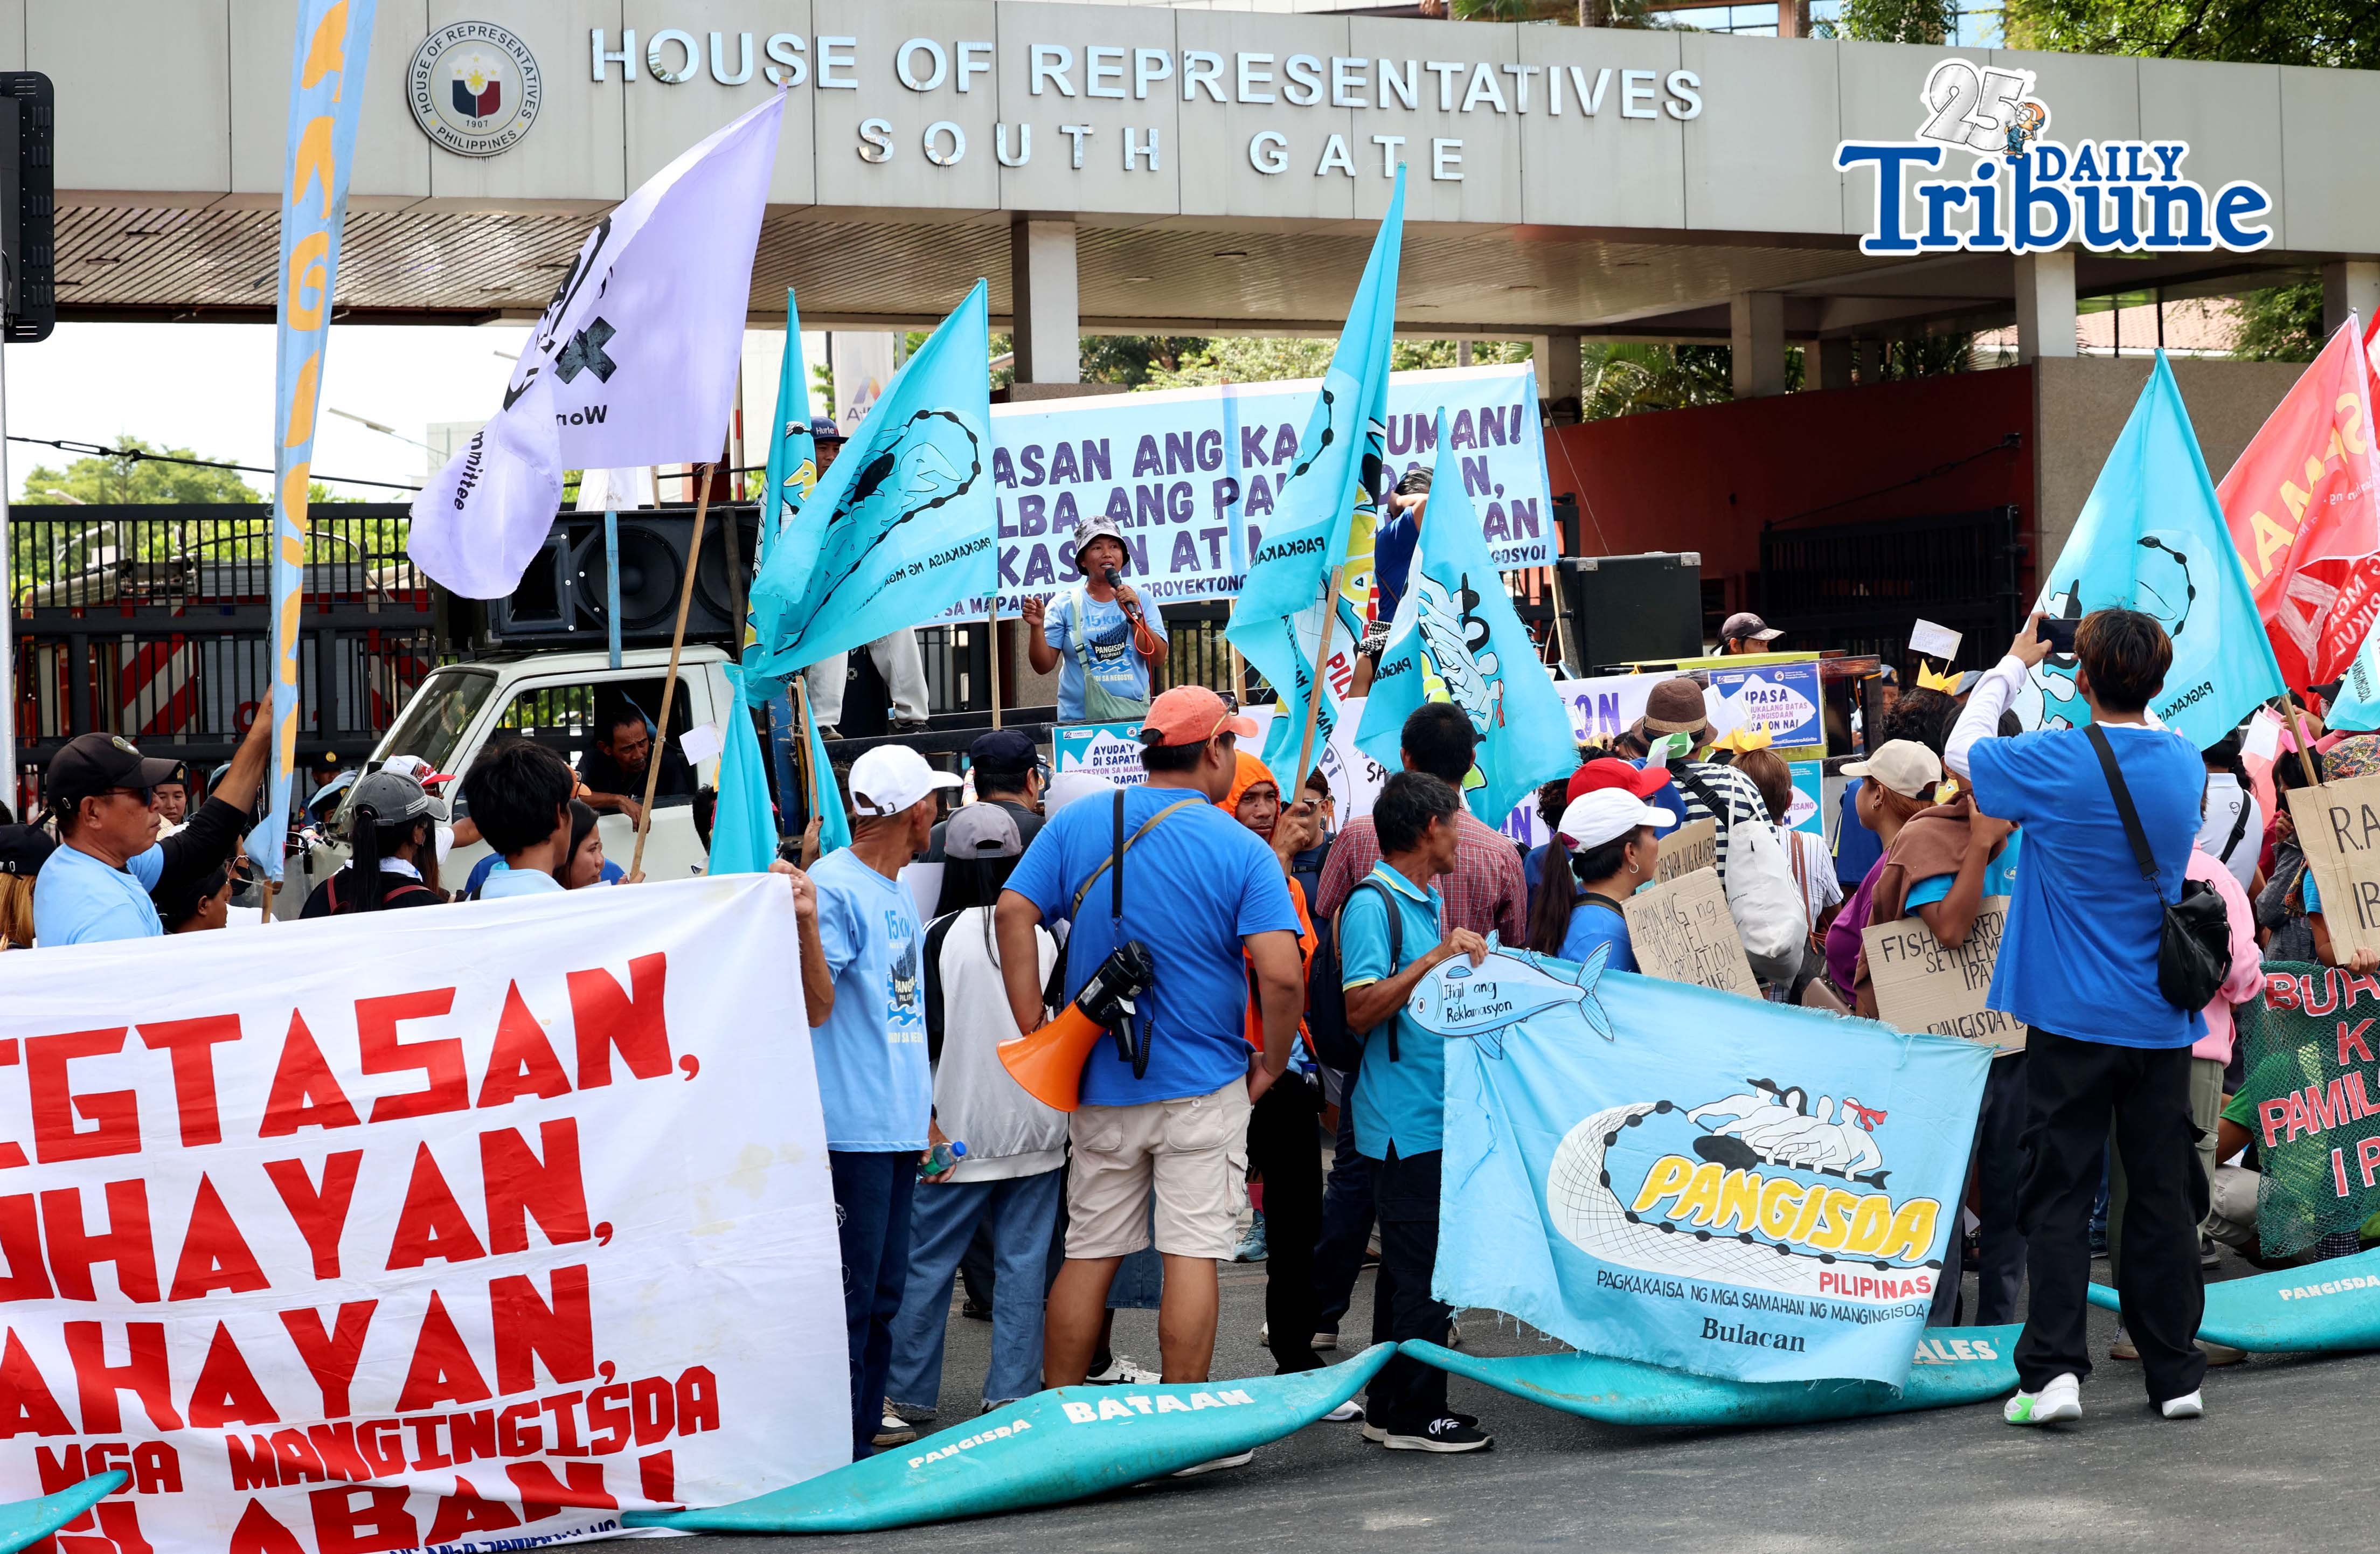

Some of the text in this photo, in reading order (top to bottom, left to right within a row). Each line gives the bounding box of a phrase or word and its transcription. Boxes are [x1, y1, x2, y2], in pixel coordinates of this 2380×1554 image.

[417, 25, 537, 119] HOUSE OF REPRESENTATIVES
[590, 29, 1702, 120] HOUSE OF REPRESENTATIVES
[436, 126, 516, 150] PHILIPPINES
[466, 120, 488, 128] 1907
[858, 117, 1465, 181] SOUTH GATE
[1133, 429, 1223, 477] ANG
[1105, 481, 1194, 528] ANG
[997, 535, 1149, 589] KASN
[1170, 526, 1228, 573] AT
[1086, 615, 1122, 627] 15 KM
[1095, 642, 1125, 654] PANGISDA
[1745, 689, 1789, 704] IPASA
[1751, 702, 1807, 713] UKALANG BATAS
[1093, 743, 1135, 755] AYUDA'Y
[1093, 757, 1102, 766] DI
[885, 910, 899, 940] 15
[1696, 900, 1717, 926] ng
[1443, 981, 1497, 1004] Itigil ang
[1447, 1000, 1513, 1023] Reklamasyon
[1927, 1010, 2007, 1039] PANGISDA
[1630, 1155, 1942, 1262] PANGISDA
[1597, 1269, 1925, 1326] PAGKAKAISA NG MGA SAMAHAN NG MANGINGISDA
[1820, 1271, 1932, 1300] PILIPINAS
[2278, 1275, 2380, 1301] PANGISDA
[1700, 1316, 1806, 1353] Bulacan
[35, 1365, 720, 1496] MGA MANGINGISDA
[907, 1389, 1255, 1469] PANGISDA BATAAN
